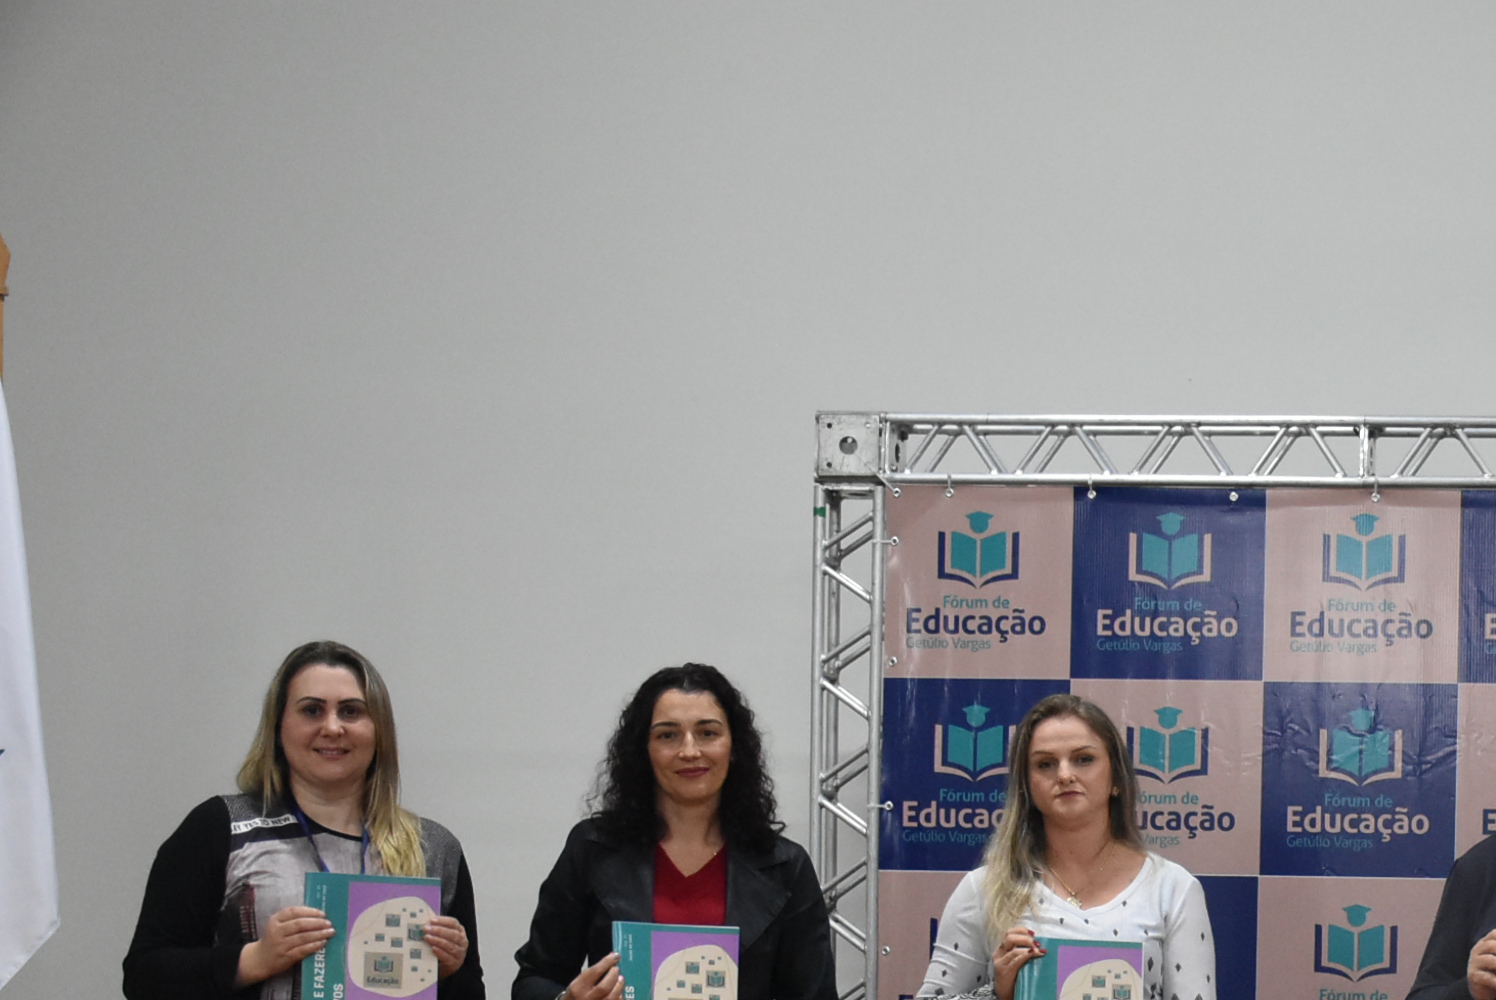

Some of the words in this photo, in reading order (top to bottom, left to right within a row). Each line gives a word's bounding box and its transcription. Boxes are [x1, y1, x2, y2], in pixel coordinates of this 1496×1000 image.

[943, 595, 988, 609] Fórum
[992, 595, 1009, 609] de
[1135, 597, 1180, 611] Fórum
[1184, 597, 1202, 612] de
[1328, 599, 1374, 613] Fórum
[1378, 599, 1396, 614] de
[905, 608, 1046, 644] Educação
[1097, 610, 1239, 646] Educação
[1290, 612, 1433, 648] Educação
[951, 637, 990, 653] Vargas
[1143, 640, 1182, 655] Vargas
[1337, 642, 1376, 657] Vargas
[940, 788, 984, 802] Fórum
[1139, 792, 1176, 805] órum
[1181, 792, 1198, 806] de
[1325, 794, 1370, 808] Fórum
[1375, 795, 1392, 809] de
[1286, 807, 1429, 843] Educação
[948, 831, 987, 846] Vargas
[1333, 837, 1373, 852] Vargas
